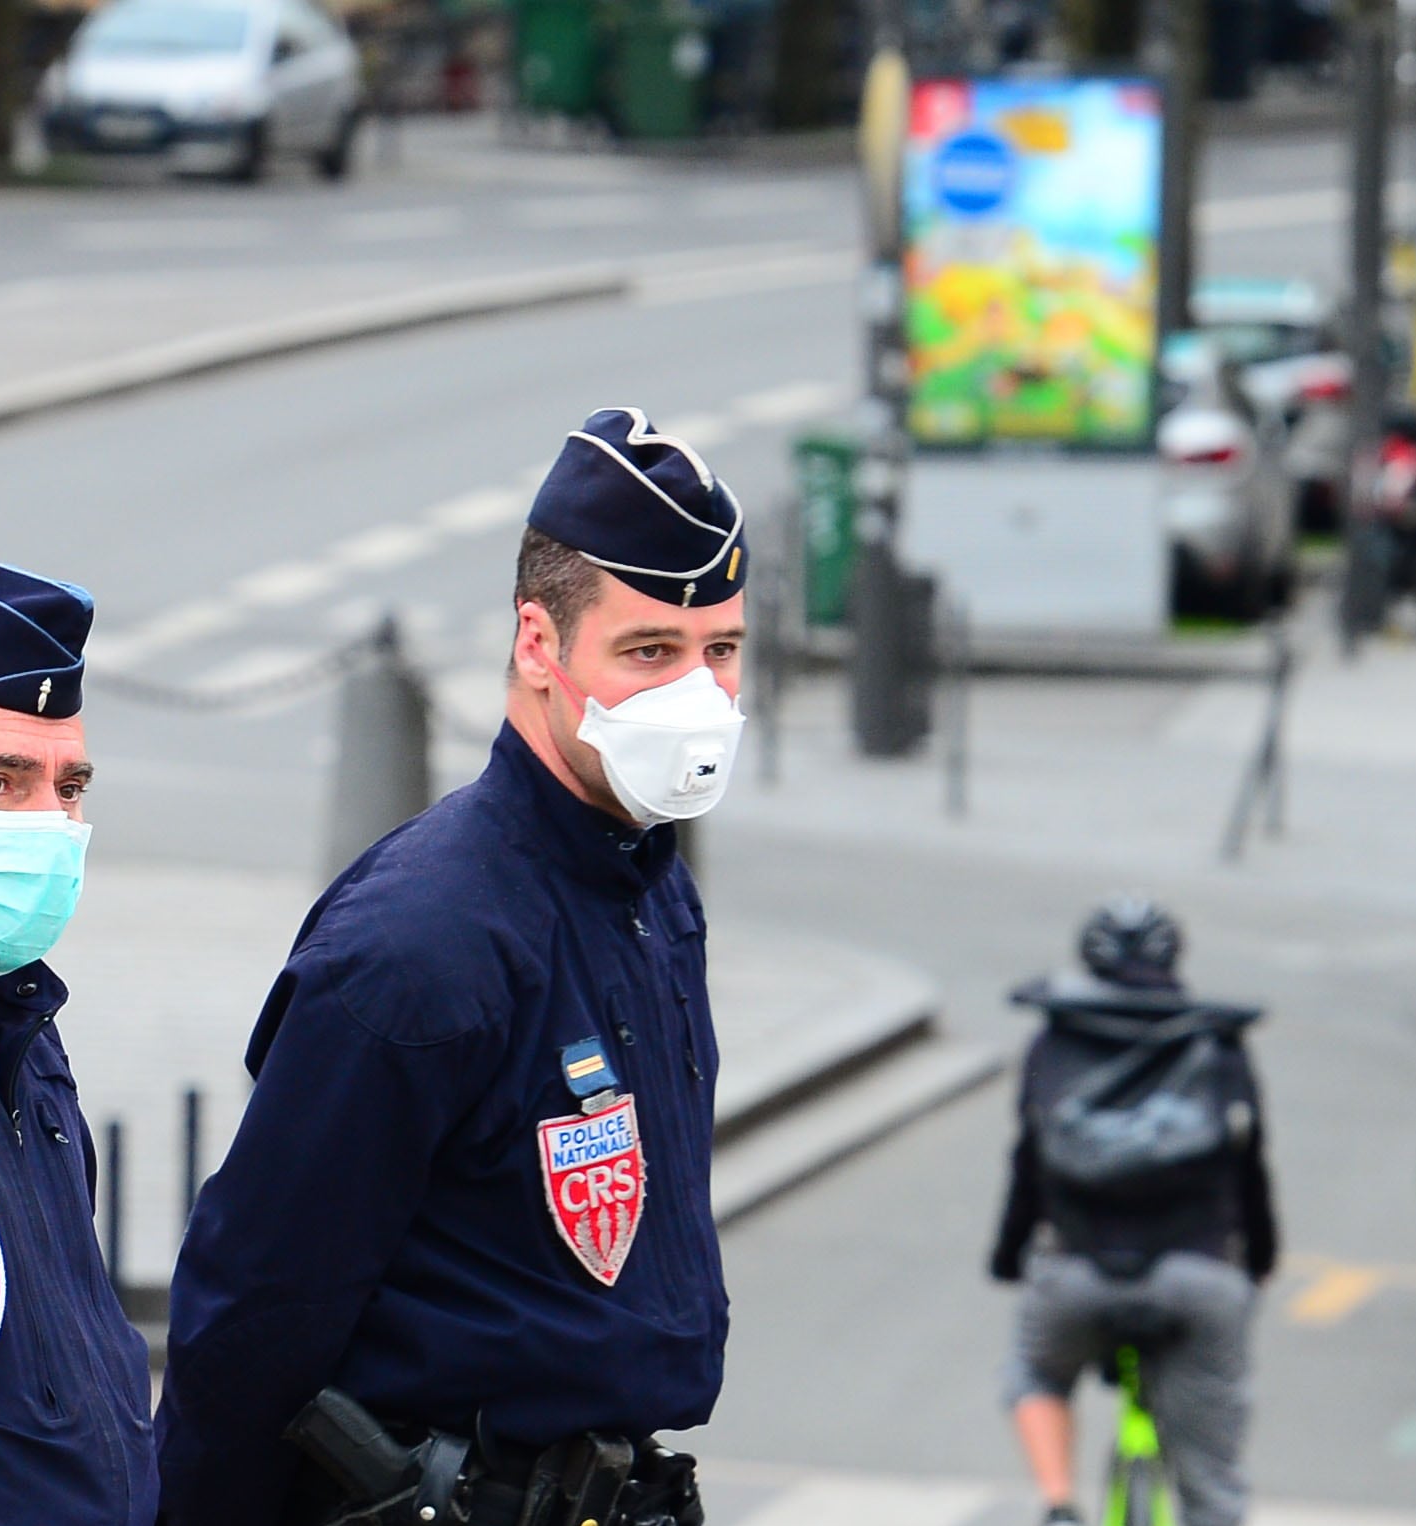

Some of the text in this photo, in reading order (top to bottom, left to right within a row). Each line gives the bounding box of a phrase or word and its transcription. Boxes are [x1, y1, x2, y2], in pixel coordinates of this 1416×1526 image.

[696, 763, 716, 776] 3M
[559, 1115, 626, 1147] POLICE
[553, 1131, 633, 1167] NATIONALE
[560, 1159, 634, 1214] CRS
